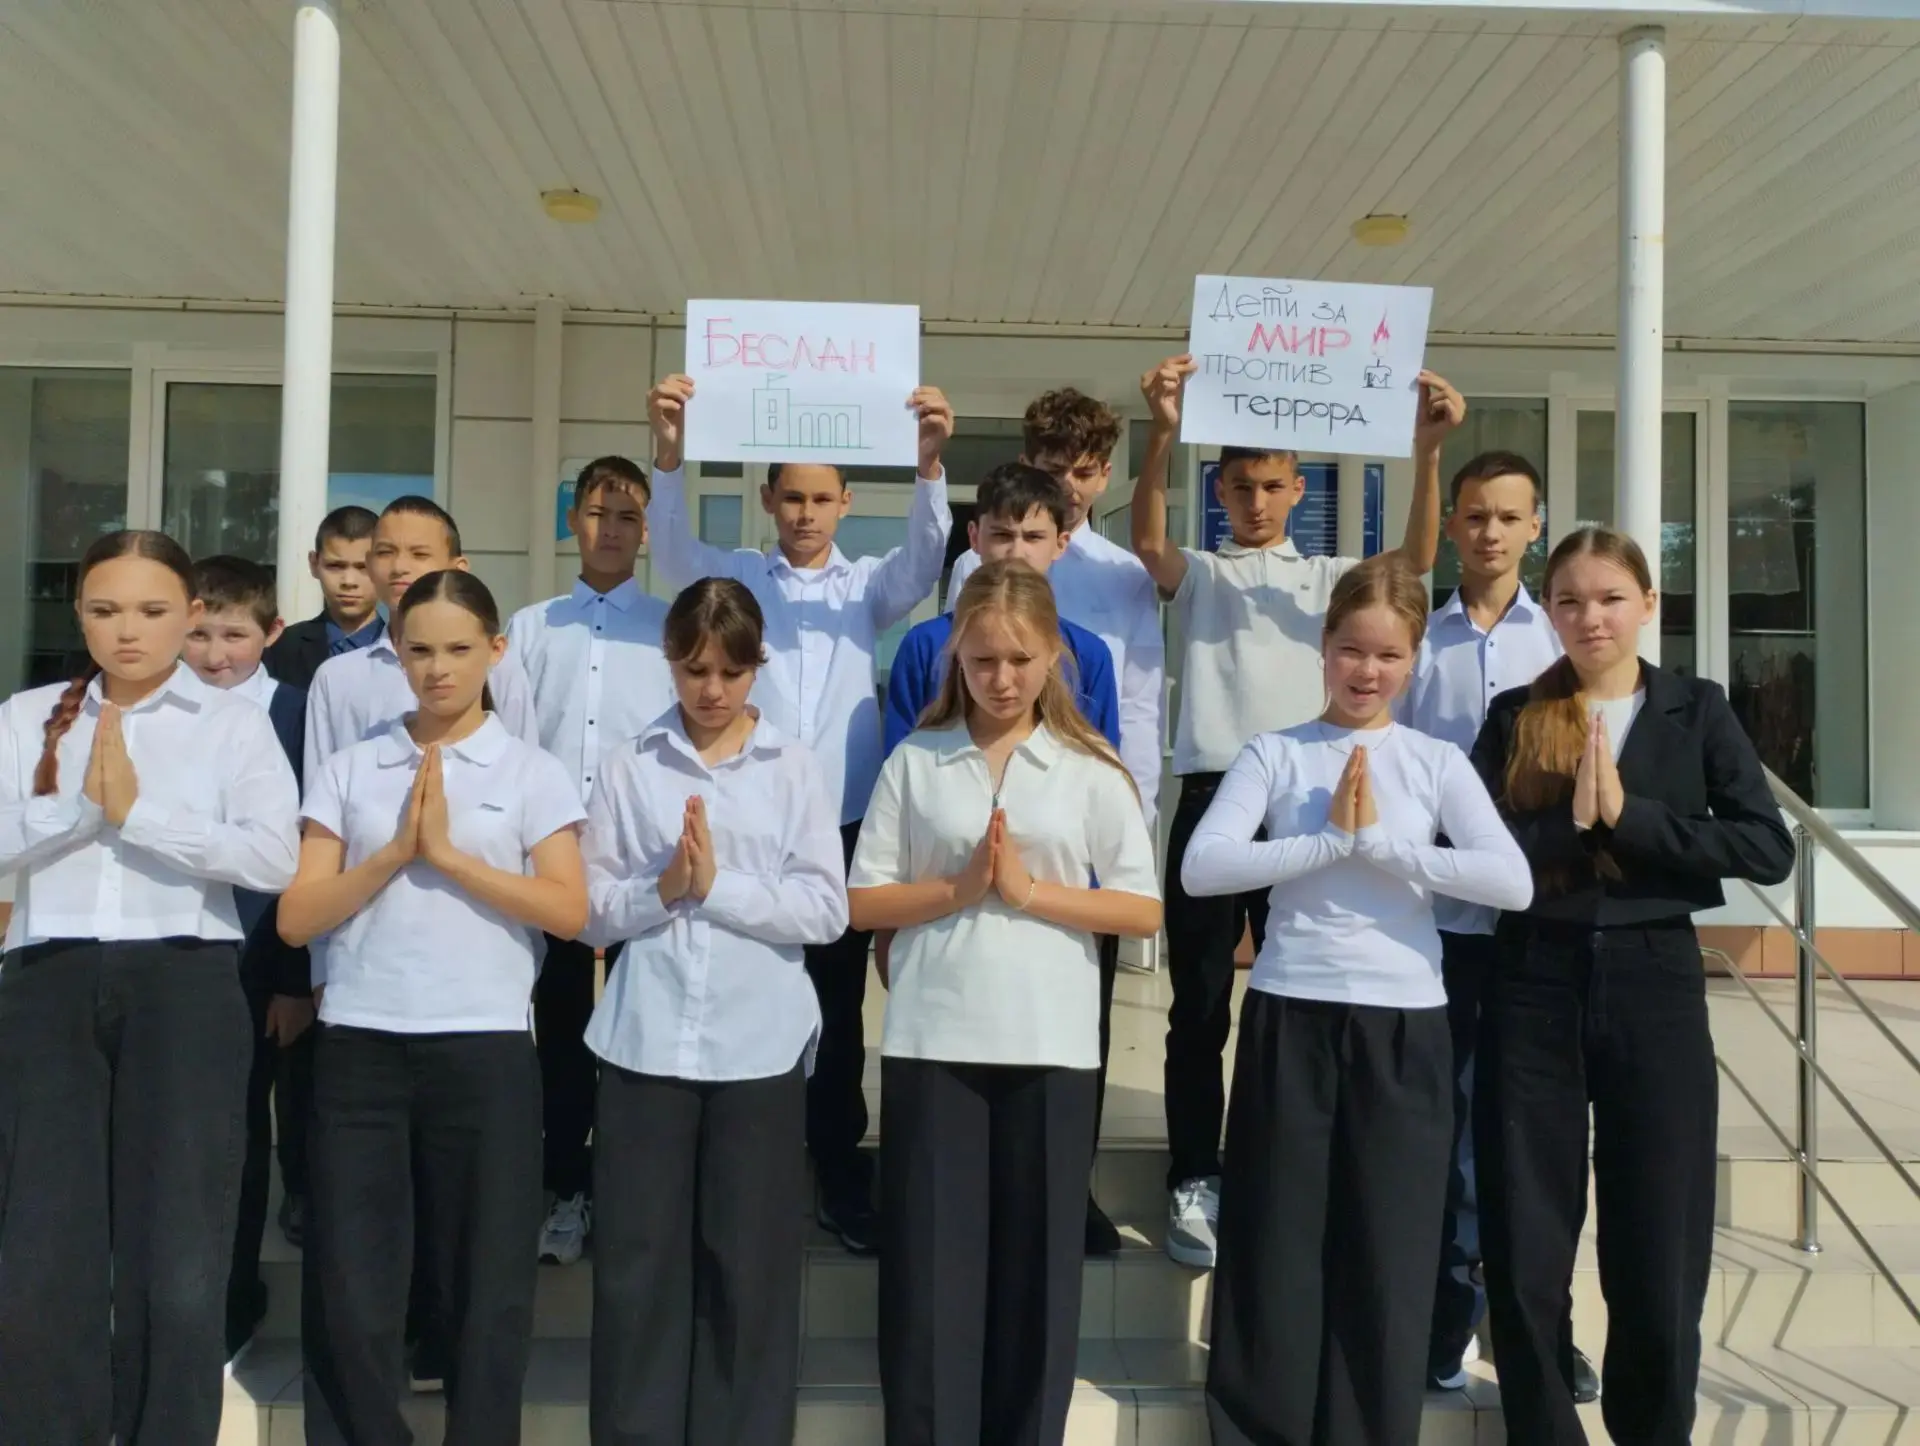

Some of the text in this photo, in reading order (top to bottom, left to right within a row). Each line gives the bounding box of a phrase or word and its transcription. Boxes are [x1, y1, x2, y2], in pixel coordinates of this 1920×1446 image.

[1208, 282, 1298, 322] Дети
[1247, 322, 1352, 357] МИР
[1204, 354, 1333, 385] против
